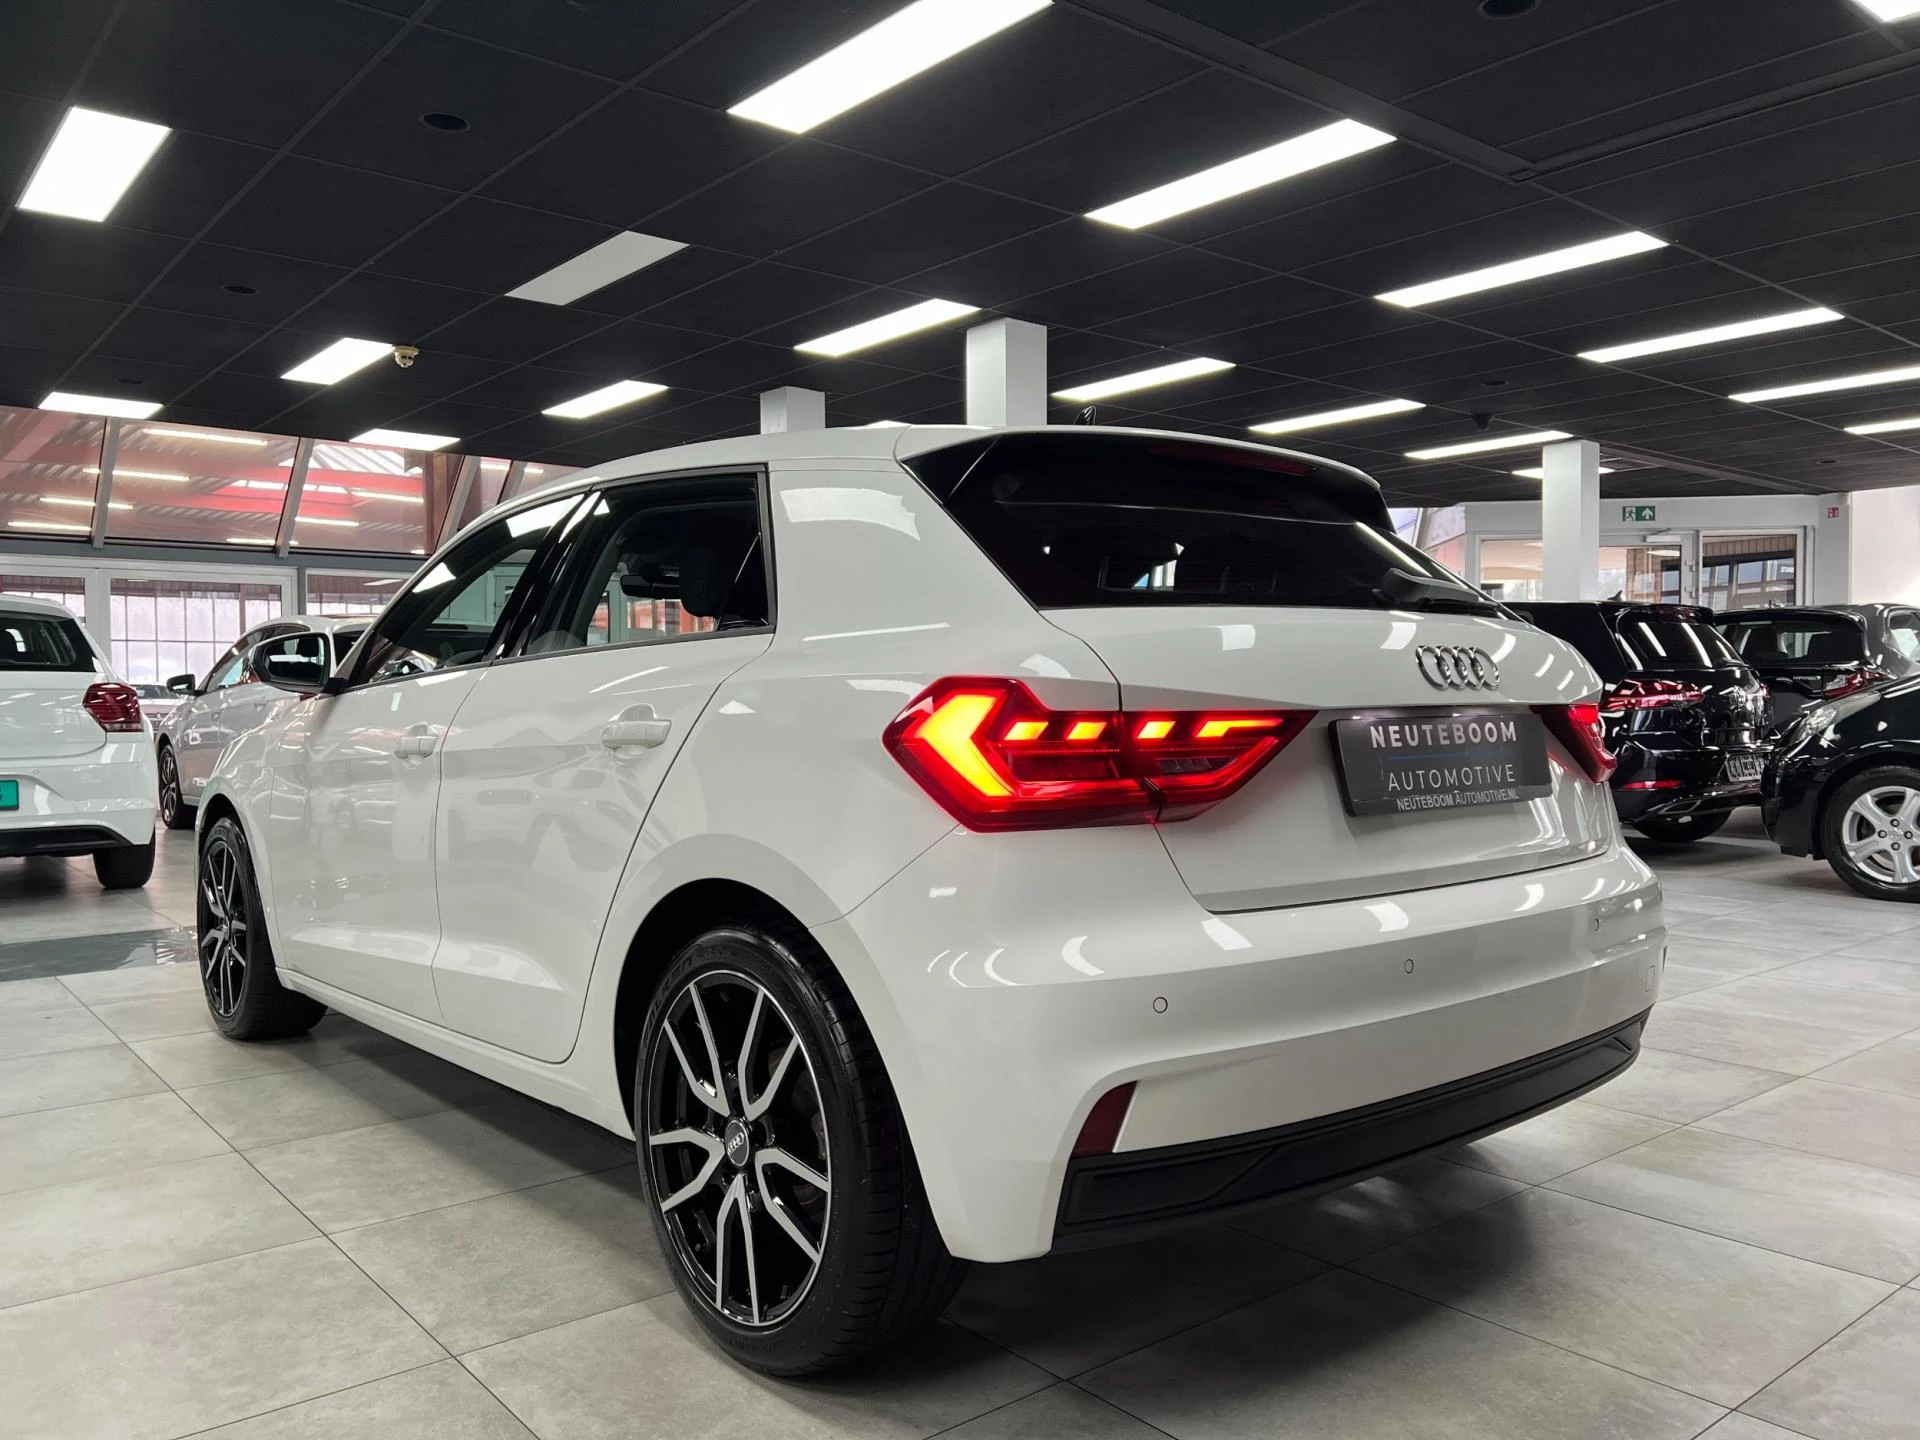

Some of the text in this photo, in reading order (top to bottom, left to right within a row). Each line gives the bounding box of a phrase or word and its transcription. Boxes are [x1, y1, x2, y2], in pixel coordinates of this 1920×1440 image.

[1370, 721, 1517, 748] NEUTEBOOM
[1388, 764, 1516, 792] AUTOMOTIVE
[1397, 794, 1454, 811] NEUTEBOOM
